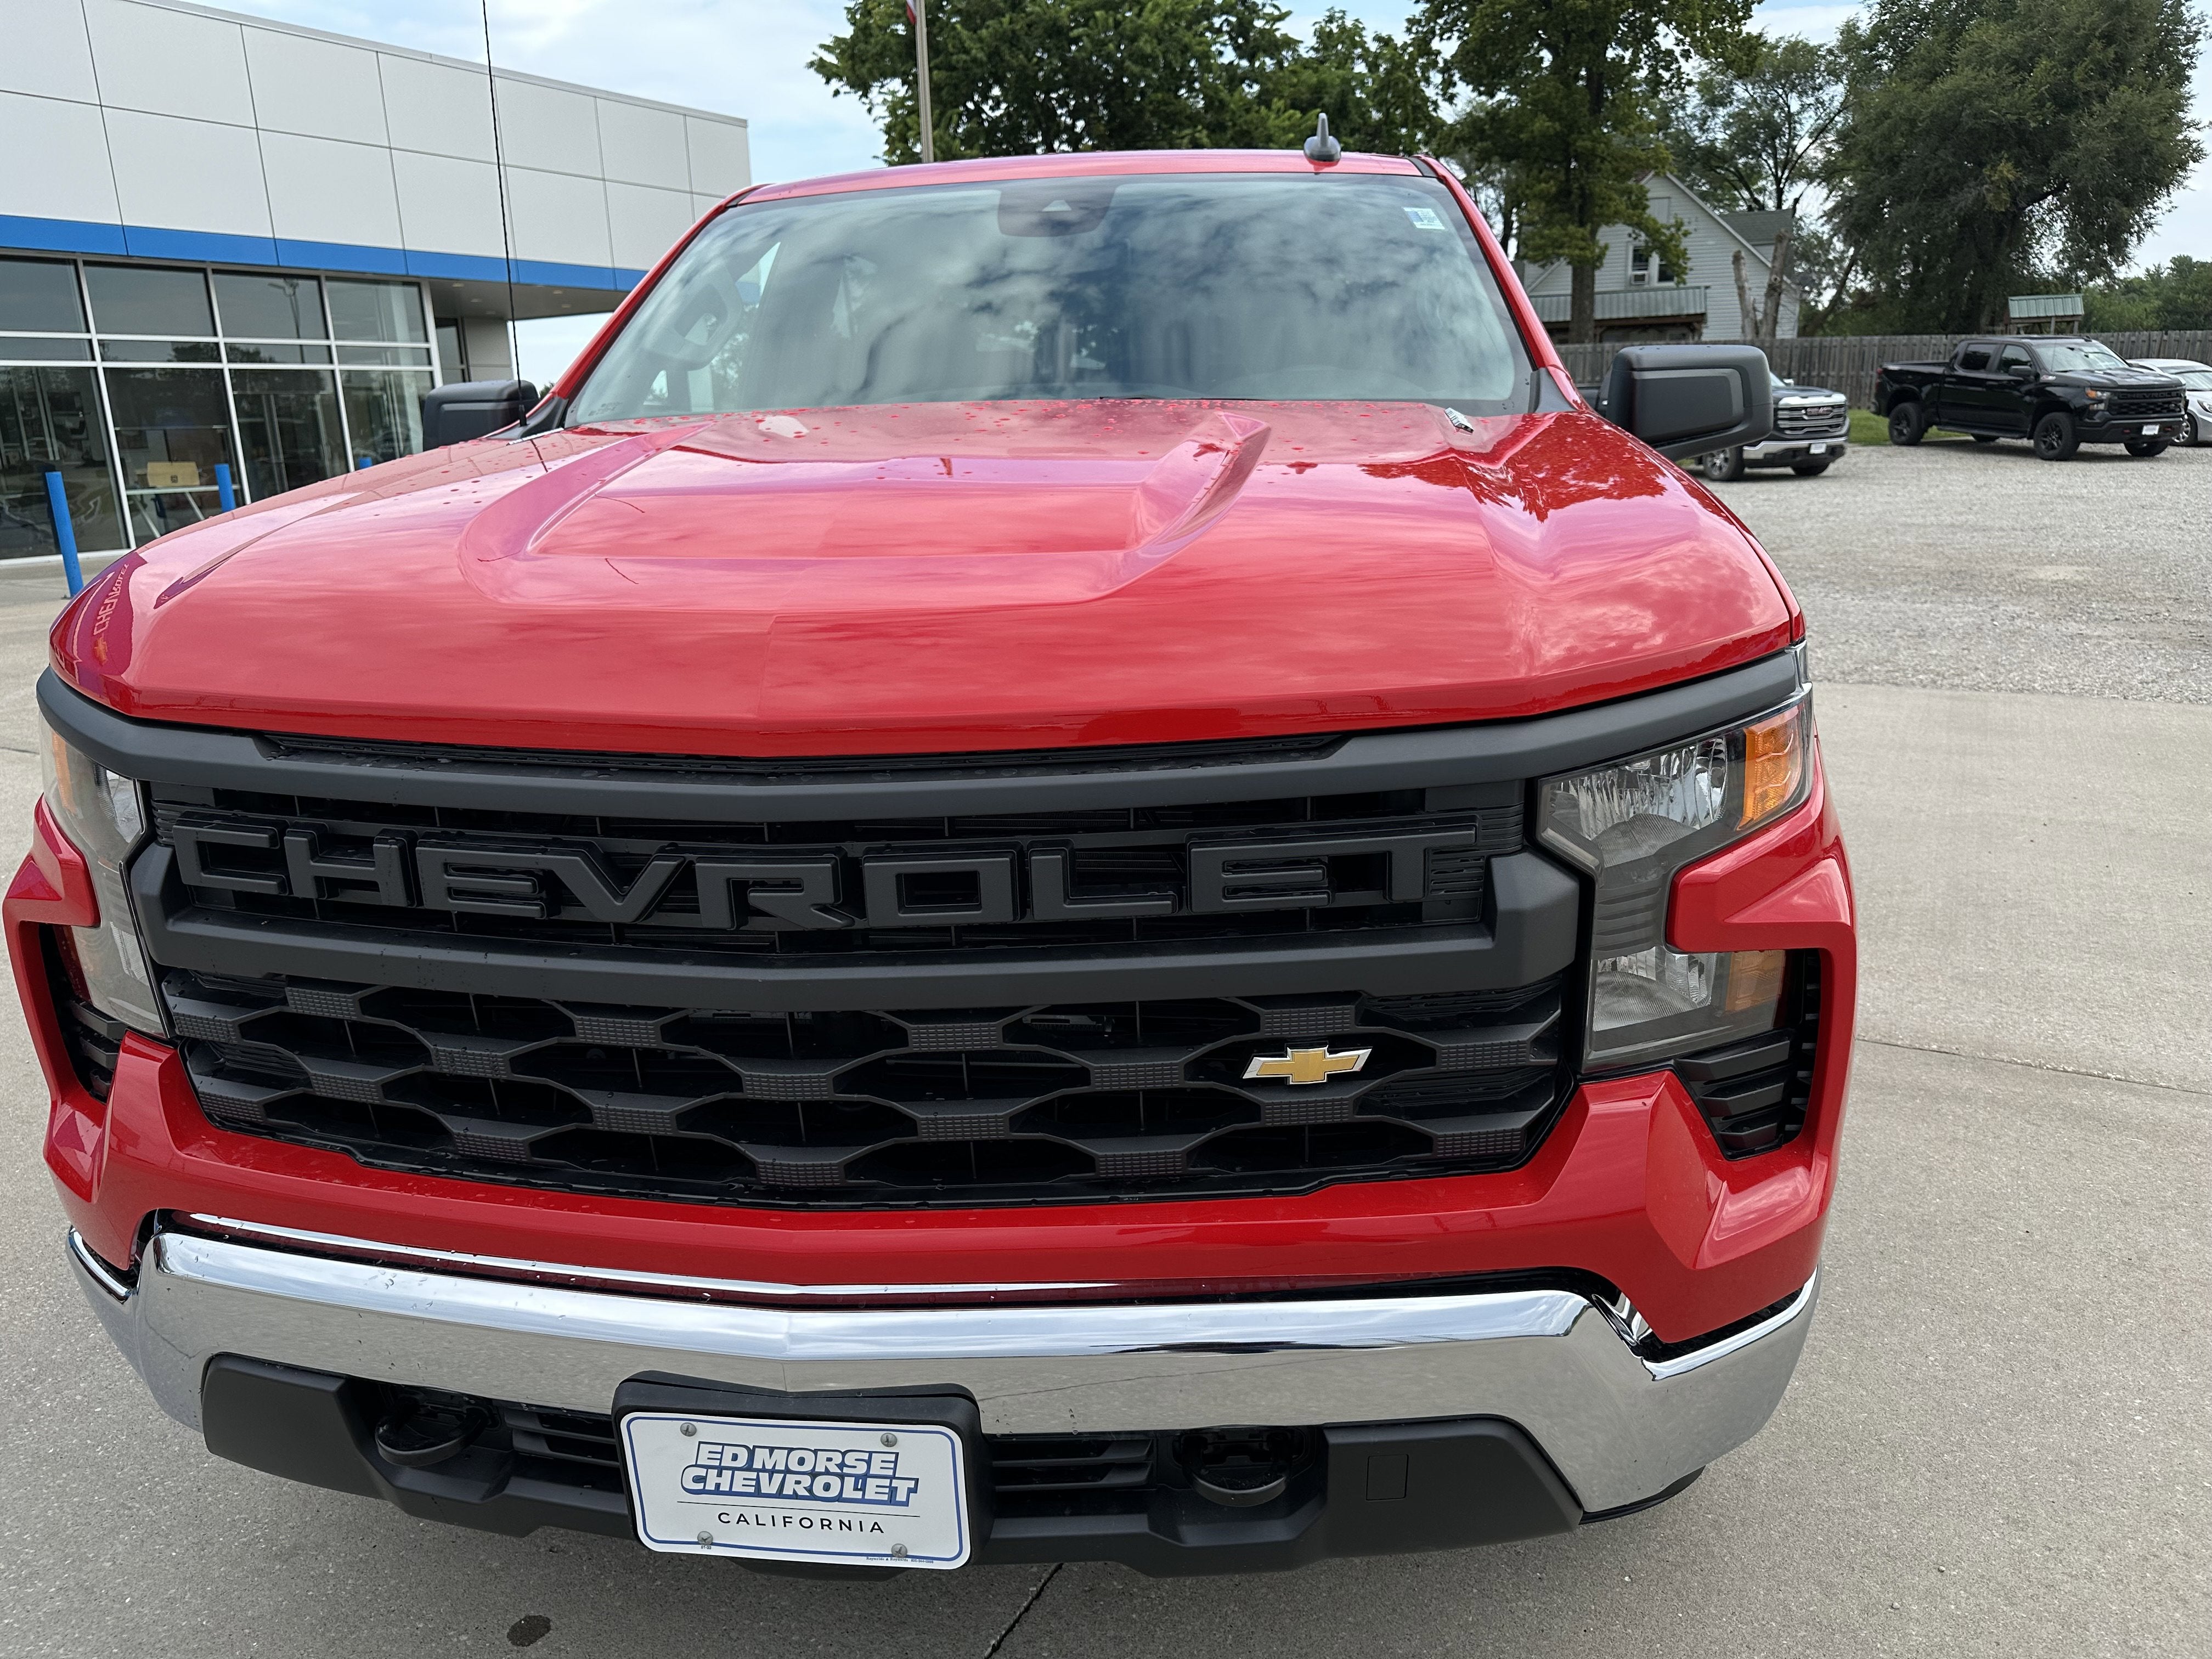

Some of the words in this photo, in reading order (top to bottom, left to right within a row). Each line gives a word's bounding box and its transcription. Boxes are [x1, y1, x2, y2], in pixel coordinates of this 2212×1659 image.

[172, 824, 1478, 932] CHEVROLET
[695, 1441, 752, 1469] ED
[751, 1446, 900, 1477] MORSE
[681, 1464, 919, 1507] CHEVROLET
[717, 1511, 885, 1534] CALIFORNIA
